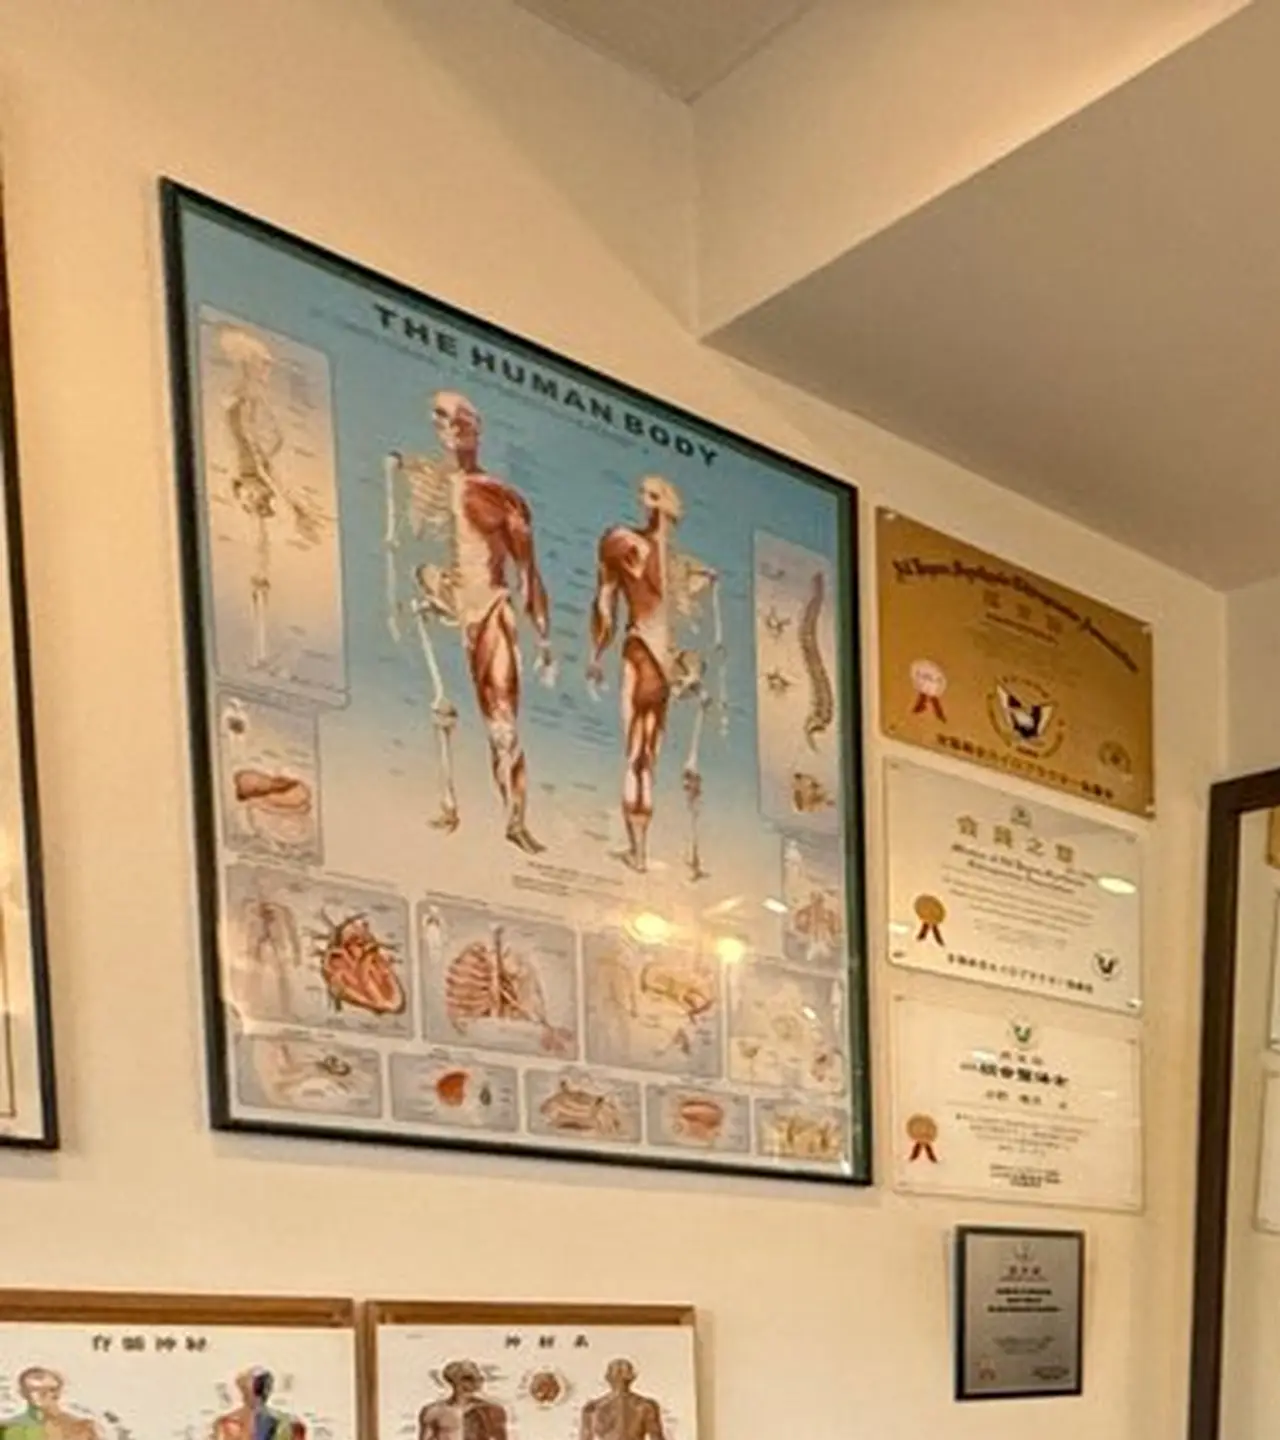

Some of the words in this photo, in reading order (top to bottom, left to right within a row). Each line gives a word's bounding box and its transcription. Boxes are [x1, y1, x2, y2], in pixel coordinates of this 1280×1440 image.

[374, 303, 458, 358] THE
[471, 346, 613, 425] HUMAN
[622, 412, 718, 467] BODY
